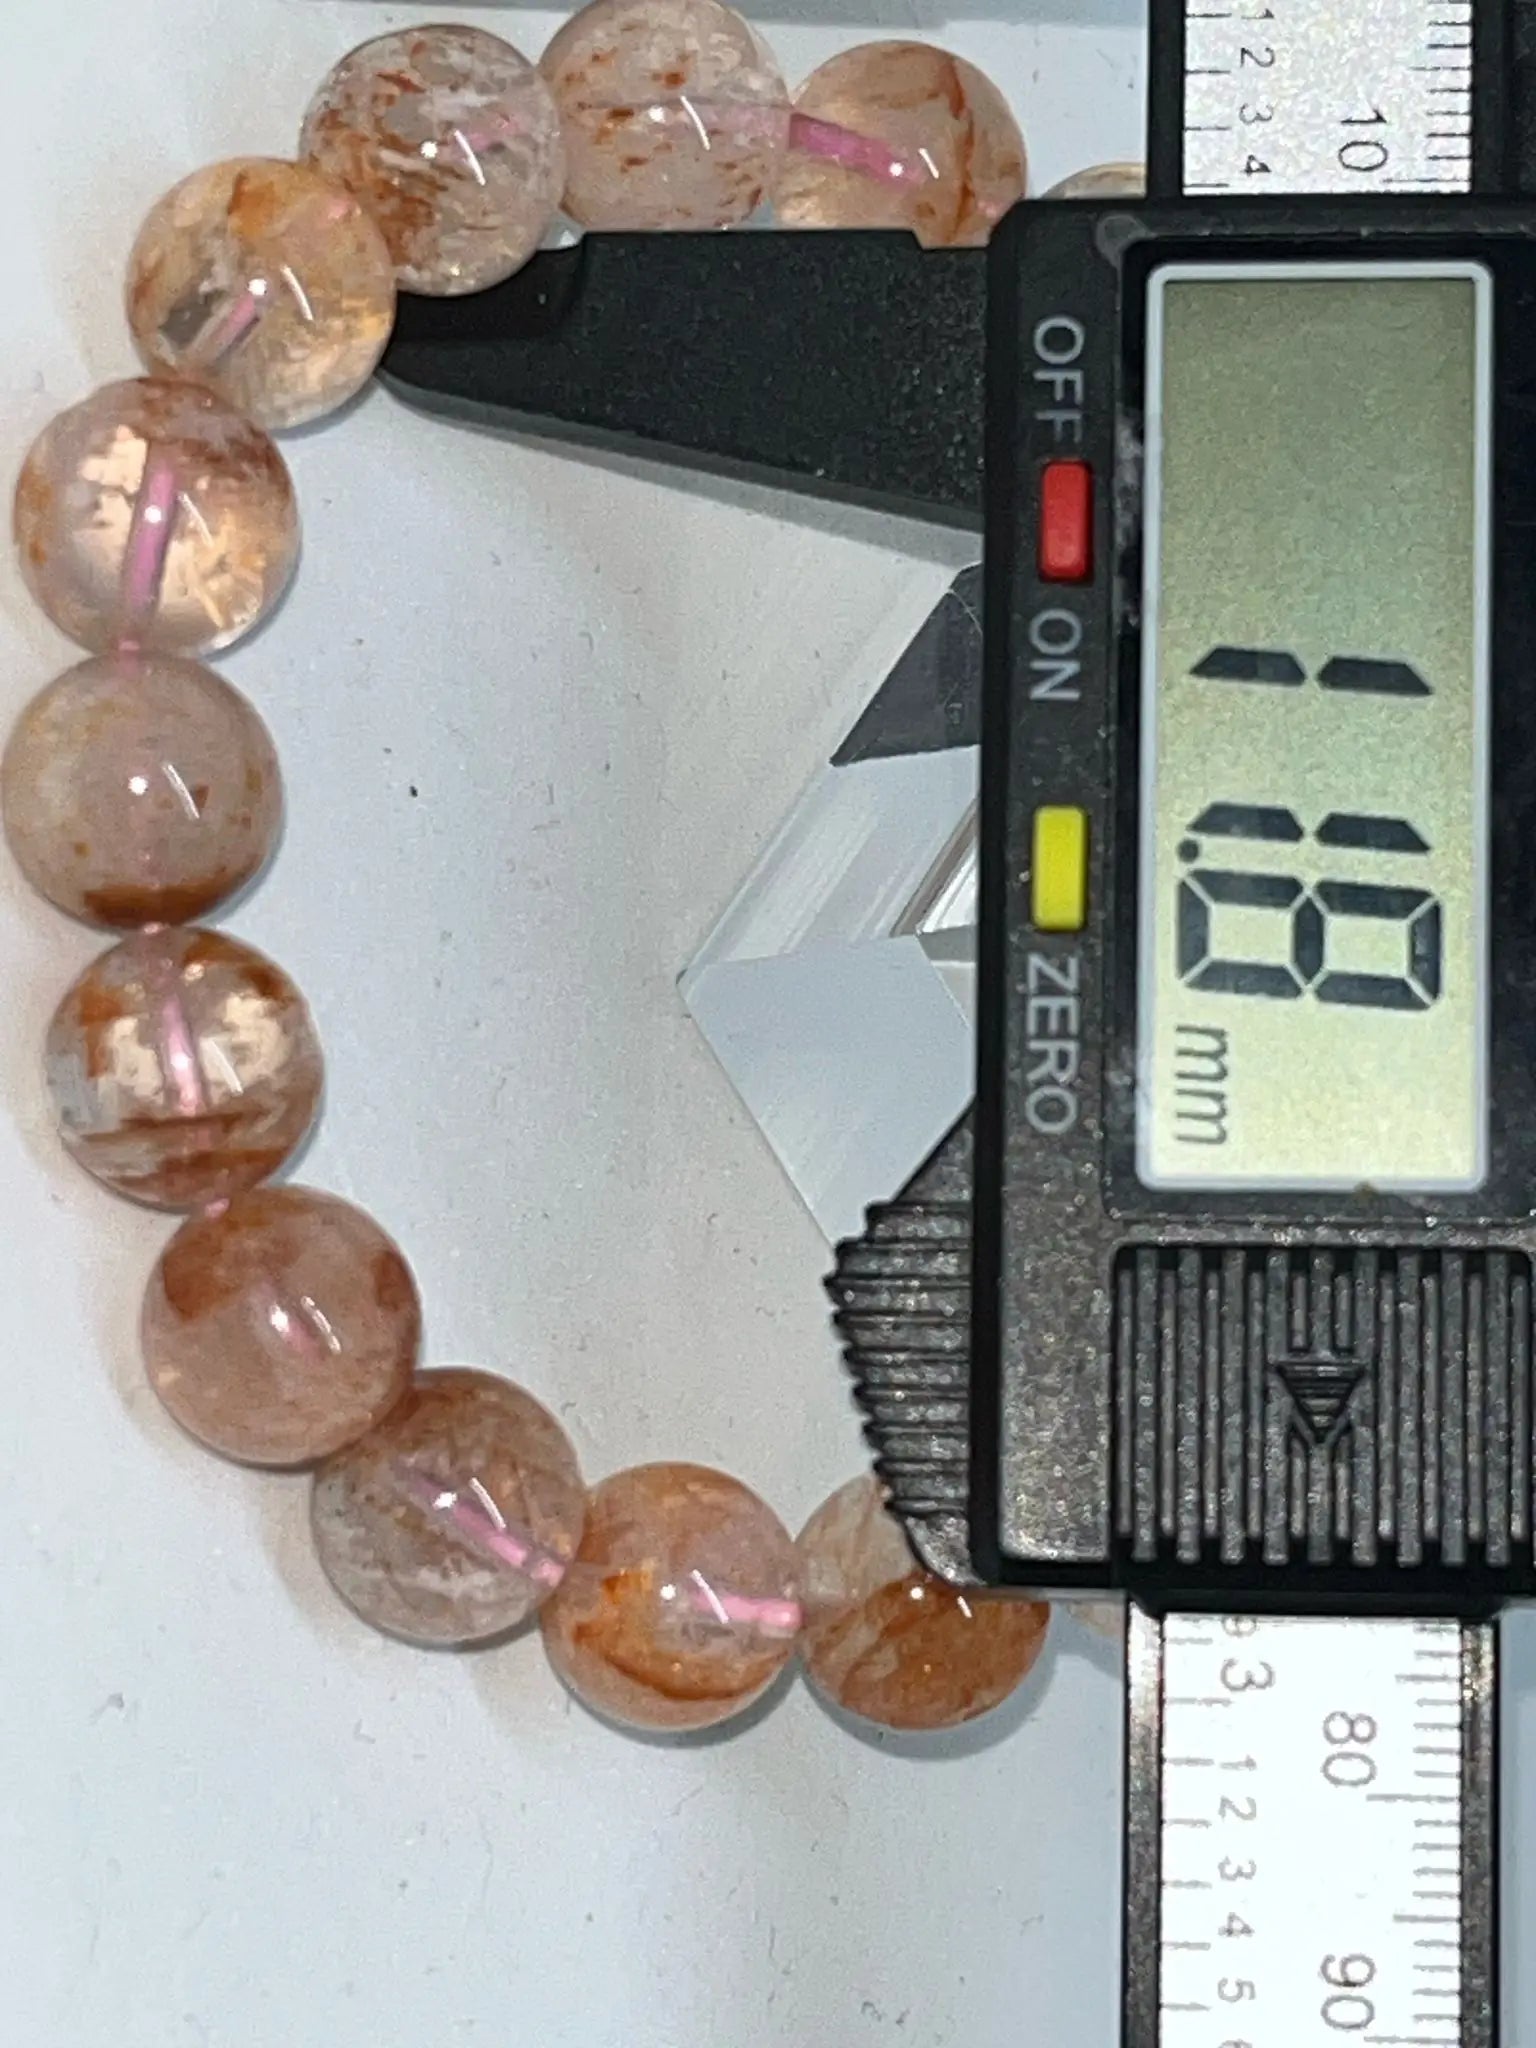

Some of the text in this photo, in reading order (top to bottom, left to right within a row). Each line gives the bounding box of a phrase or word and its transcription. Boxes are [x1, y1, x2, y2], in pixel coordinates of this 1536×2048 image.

[1240, 47, 1276, 68] 2
[1239, 103, 1273, 124] 3
[1338, 107, 1389, 172] 10
[1240, 154, 1271, 176] 4
[1033, 316, 1085, 443] OFF
[1028, 608, 1083, 700] ON
[1174, 647, 1442, 1145] 11.8 mm
[1025, 952, 1079, 1136] ZERO
[1220, 1658, 1275, 1692] 3
[1220, 1756, 1257, 1770] 1
[1218, 1796, 1257, 1821] 2
[1218, 1857, 1257, 1881] 3
[1320, 1711, 1377, 2031] 80 90
[1218, 1912, 1255, 1937] 4
[1217, 1977, 1256, 2003] 5
